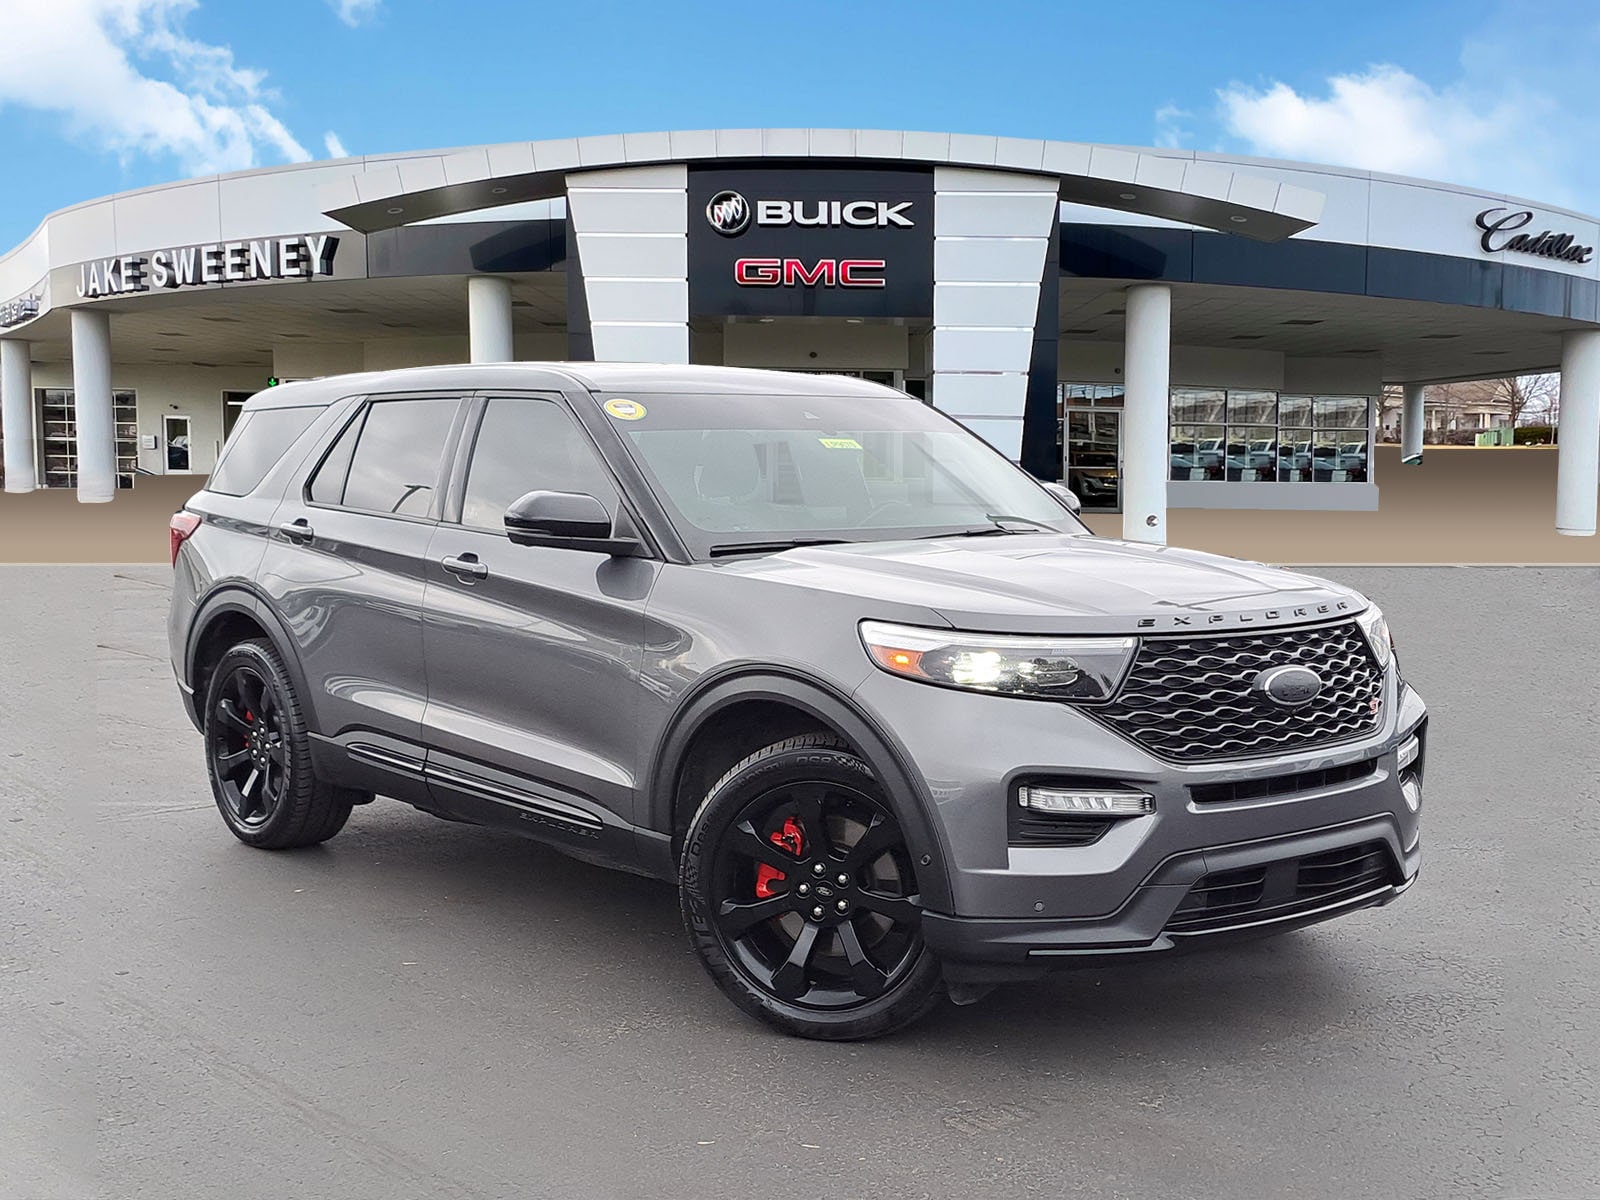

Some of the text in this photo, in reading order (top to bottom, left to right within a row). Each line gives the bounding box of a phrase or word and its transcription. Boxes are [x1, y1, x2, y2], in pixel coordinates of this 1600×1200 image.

[757, 200, 915, 227] BUICK
[1475, 207, 1594, 264] Cadillac
[76, 234, 338, 298] JAKE SWEENEY
[734, 258, 886, 287] GMC
[1137, 600, 1349, 628] EXPLORER
